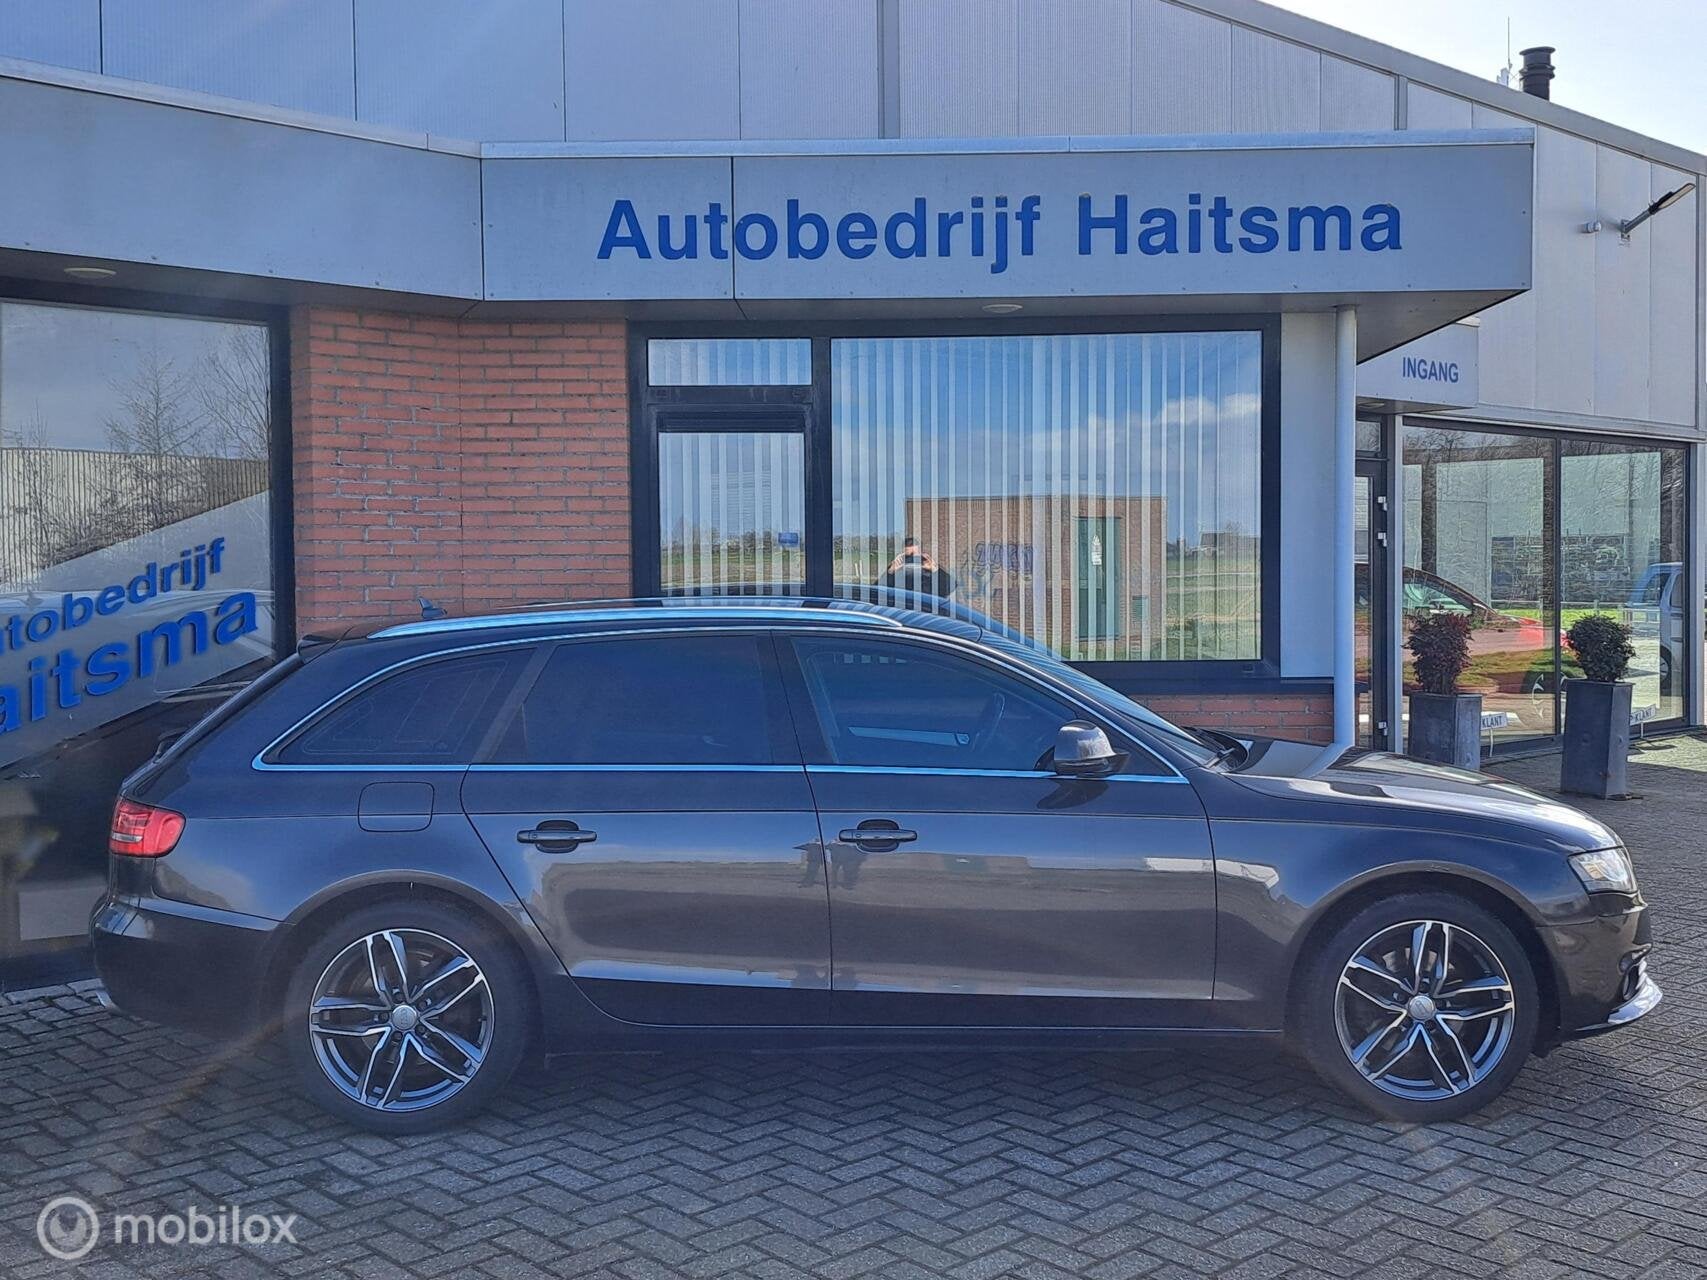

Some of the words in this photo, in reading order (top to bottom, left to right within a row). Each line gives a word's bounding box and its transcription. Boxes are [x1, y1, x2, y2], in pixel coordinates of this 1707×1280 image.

[597, 195, 1042, 274] Autobedrijf
[1078, 193, 1402, 256] Haitsma
[1402, 357, 1459, 383] INGANG
[1482, 715, 1503, 728] KLANT
